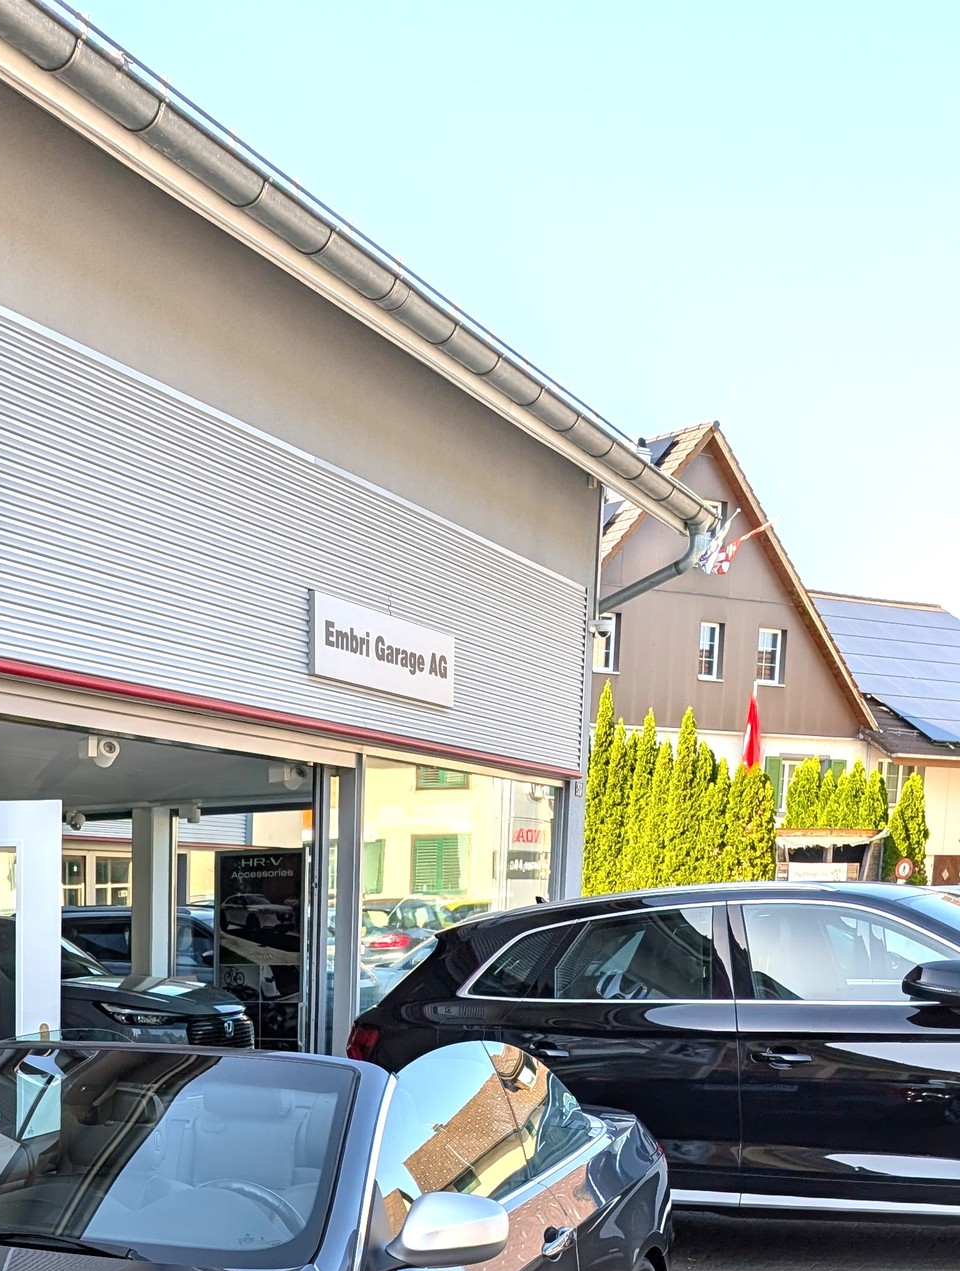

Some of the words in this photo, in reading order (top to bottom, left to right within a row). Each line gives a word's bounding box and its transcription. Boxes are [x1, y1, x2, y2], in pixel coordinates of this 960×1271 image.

[324, 619, 370, 657] Embri
[374, 635, 426, 676] Garage
[428, 652, 448, 679] AG
[241, 856, 283, 867] HR-V
[231, 869, 294, 879] Accessories
